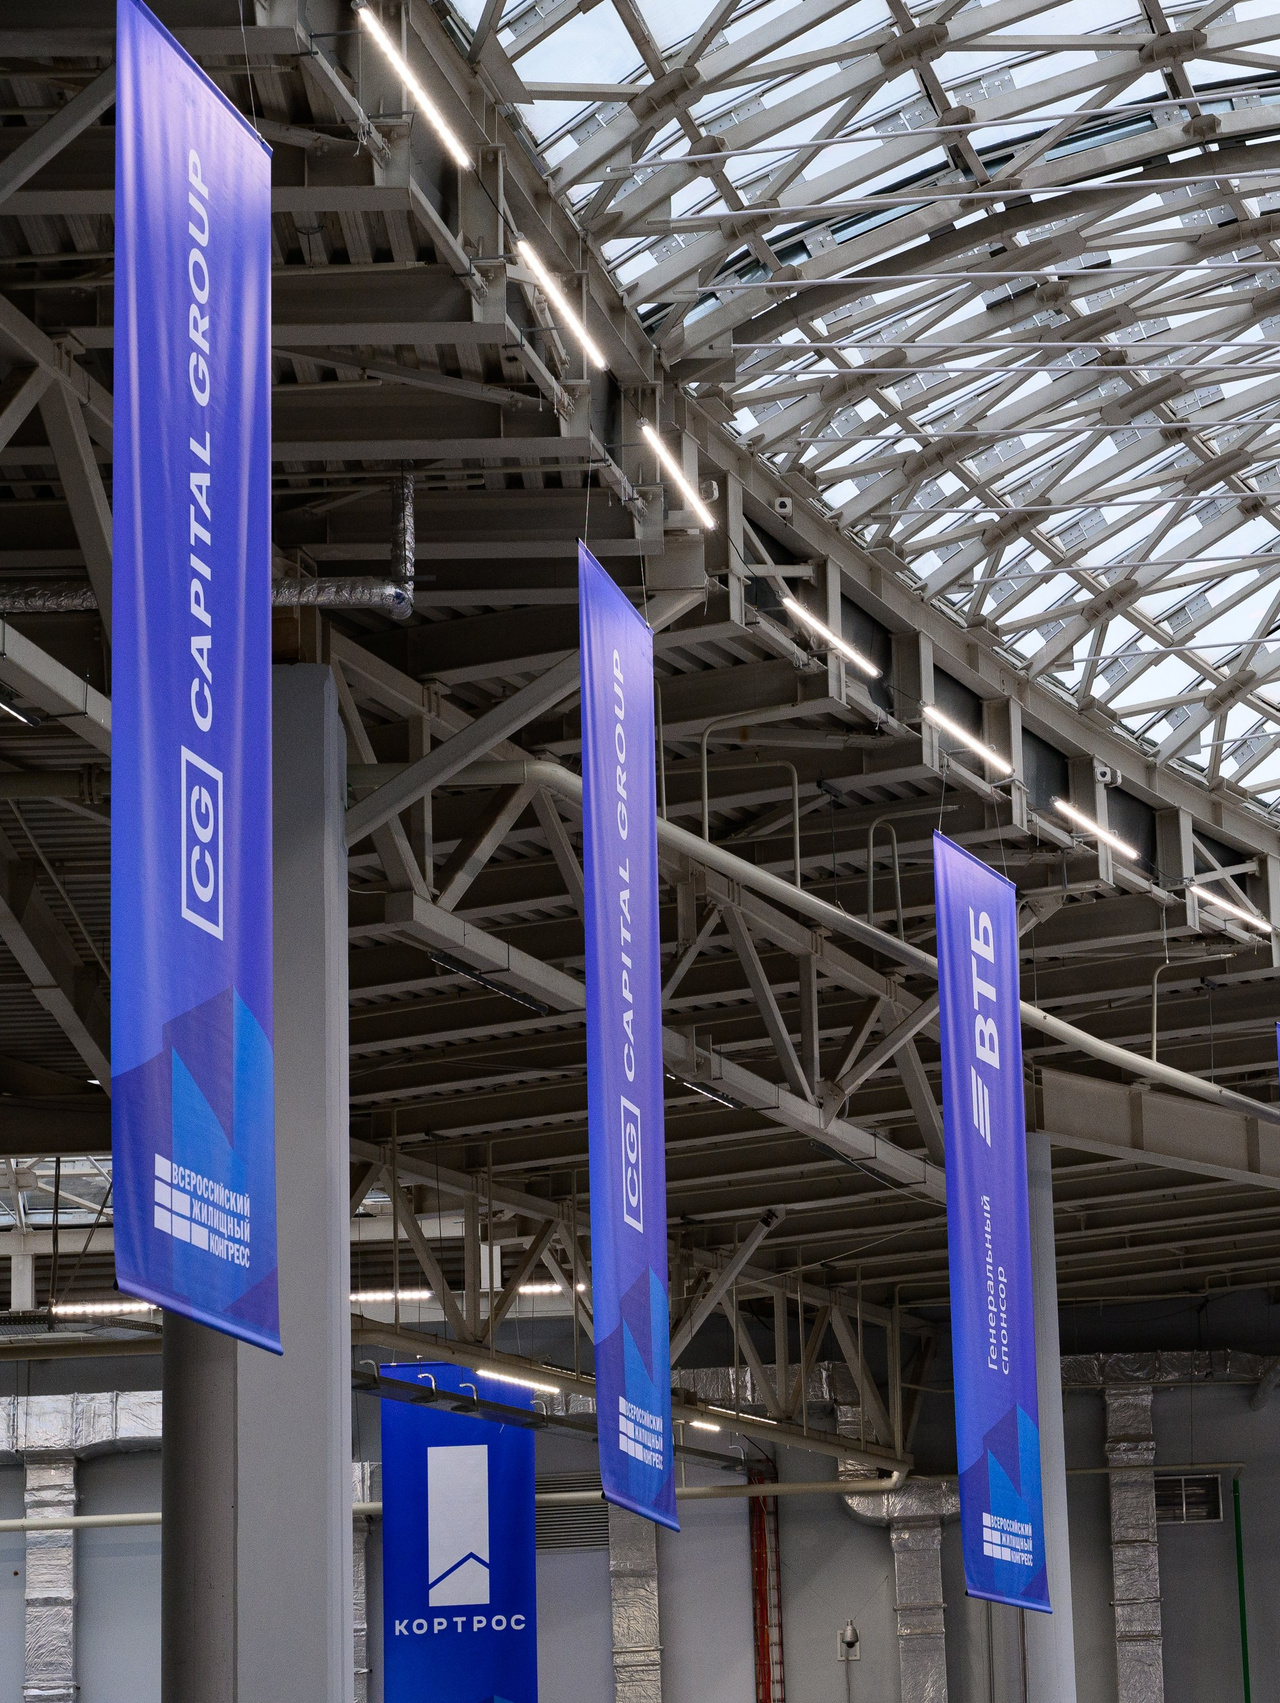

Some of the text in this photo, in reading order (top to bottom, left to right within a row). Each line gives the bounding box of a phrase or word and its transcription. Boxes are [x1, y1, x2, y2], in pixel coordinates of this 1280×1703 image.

[188, 148, 210, 407] GROUP
[189, 431, 212, 732] CAPITAL
[613, 649, 628, 840] GROUP
[618, 858, 636, 1083] CAPITAL
[968, 905, 1000, 1070] ВТБ
[172, 1162, 250, 1218] ВСЕРОССИЙСКИЙ
[192, 1198, 250, 1243] ЖИЛИЩНЫЙ
[209, 1232, 250, 1269] КОНГРЕСС
[980, 1195, 999, 1371] Генеральный
[998, 1266, 1010, 1375] спонсор
[394, 1614, 526, 1636] КОРТРОС
